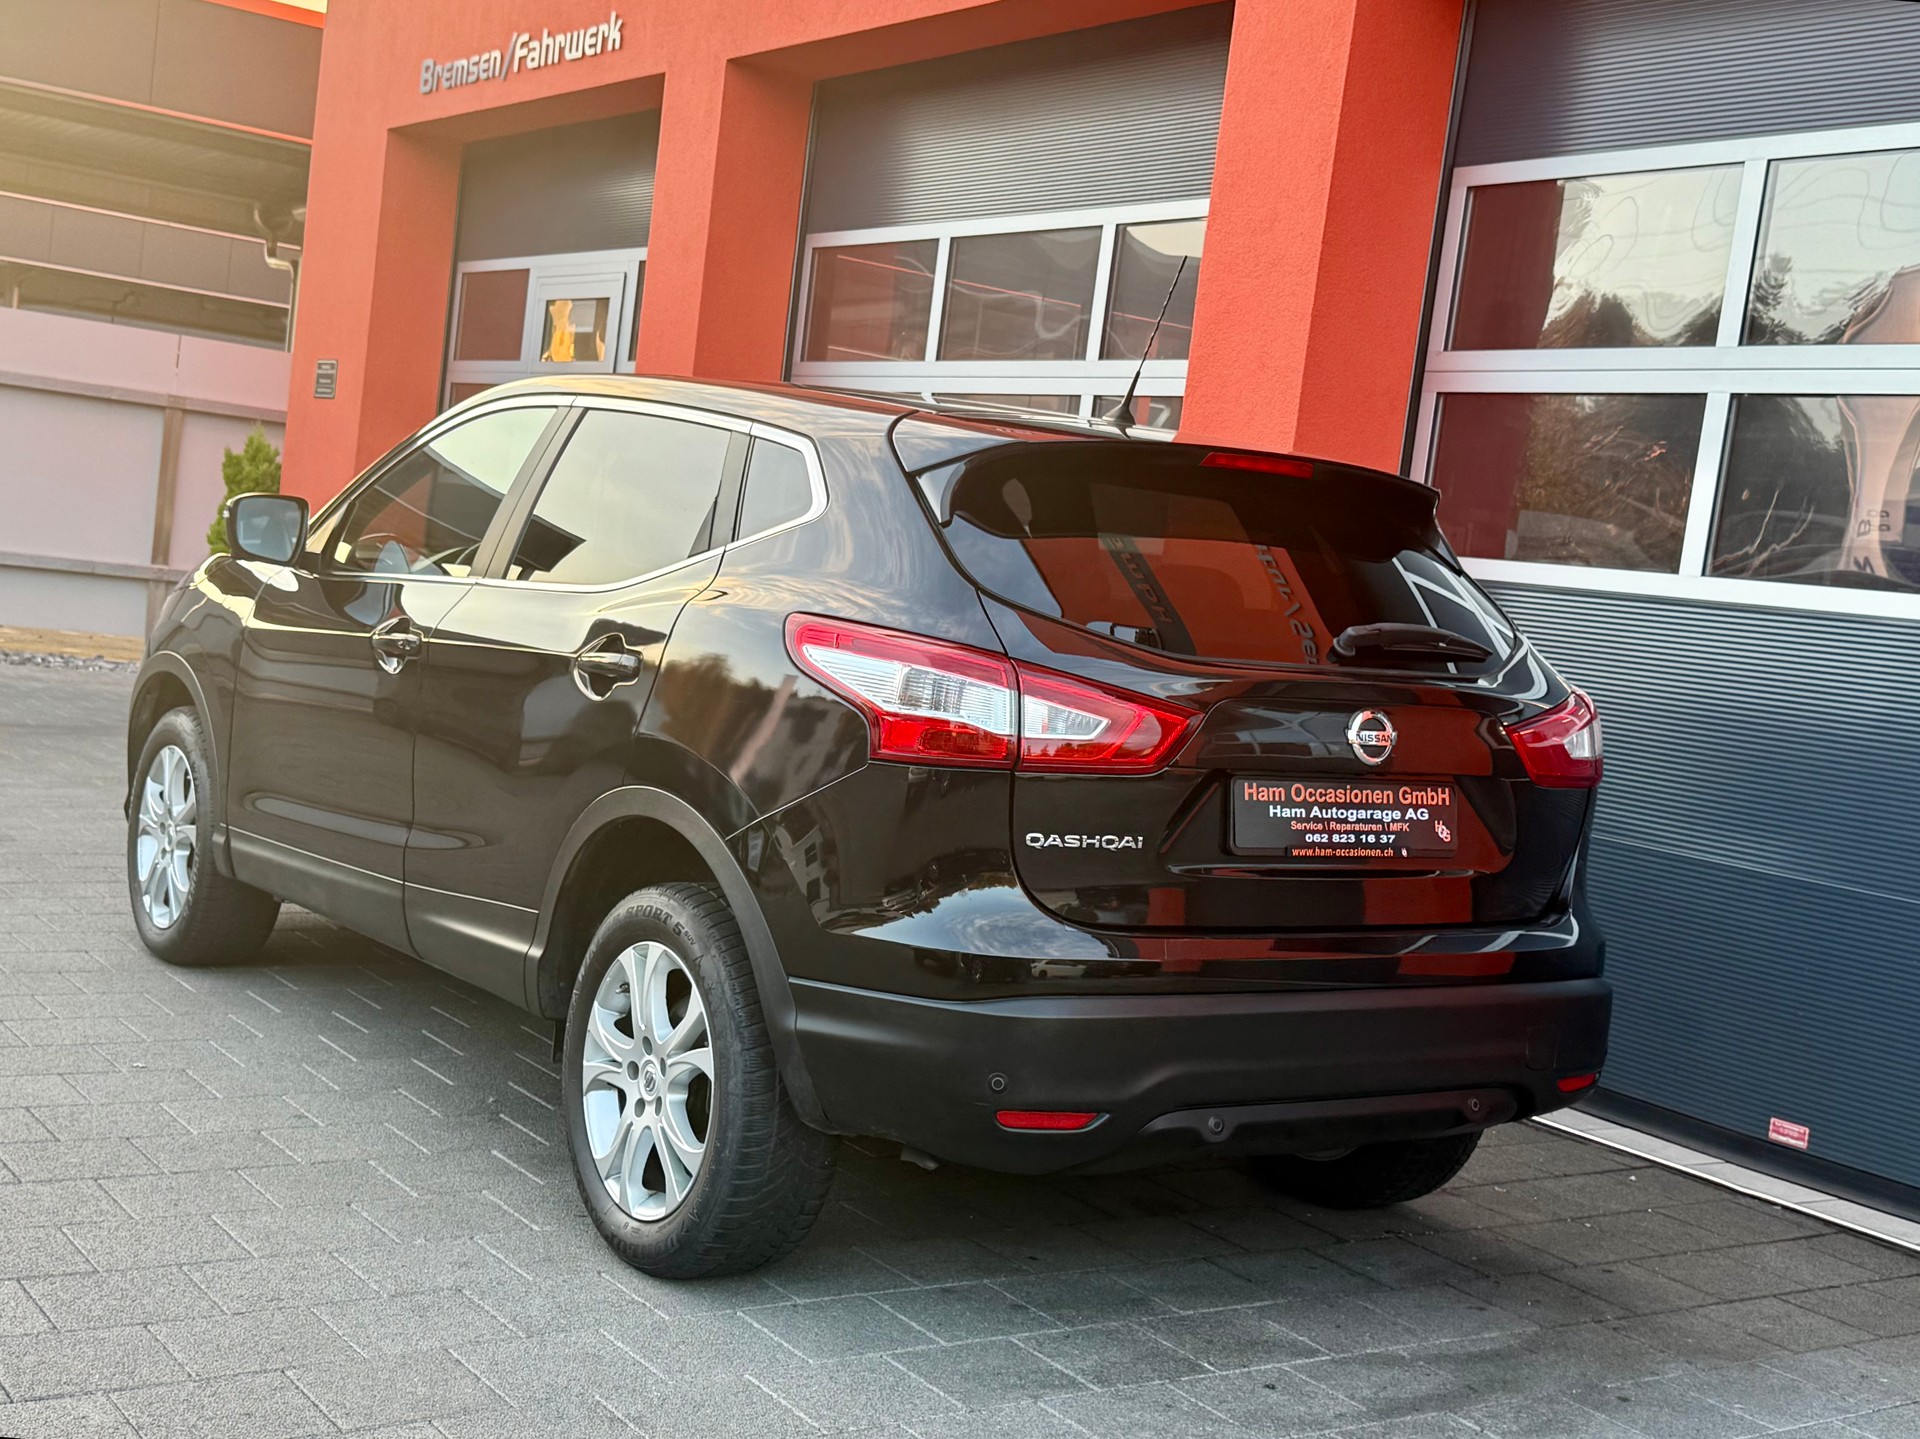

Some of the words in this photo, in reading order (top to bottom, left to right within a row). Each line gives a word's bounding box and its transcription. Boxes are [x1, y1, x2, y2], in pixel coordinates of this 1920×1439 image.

[420, 10, 623, 95] Bremsen/Fahrwerk
[1356, 733, 1393, 743] NISSAN
[1244, 782, 1285, 801] Ham
[1291, 783, 1394, 804] Occasionen
[1399, 786, 1450, 806] GmbH
[1269, 804, 1306, 818] Ham
[1310, 805, 1402, 822] Autogarage
[1405, 807, 1429, 820] AG
[1290, 821, 1323, 831] Service
[1329, 821, 1382, 833] Reparaturen
[1389, 822, 1410, 832] MFK
[1025, 832, 1144, 851] QASHQAI
[1305, 833, 1329, 843] 062
[1332, 834, 1356, 843] 823
[1360, 834, 1376, 843] 16
[1380, 834, 1396, 844] 37
[1292, 846, 1394, 857] www.ham-occasionen.ch
[625, 904, 674, 926] SPORT
[672, 920, 685, 937] 5
